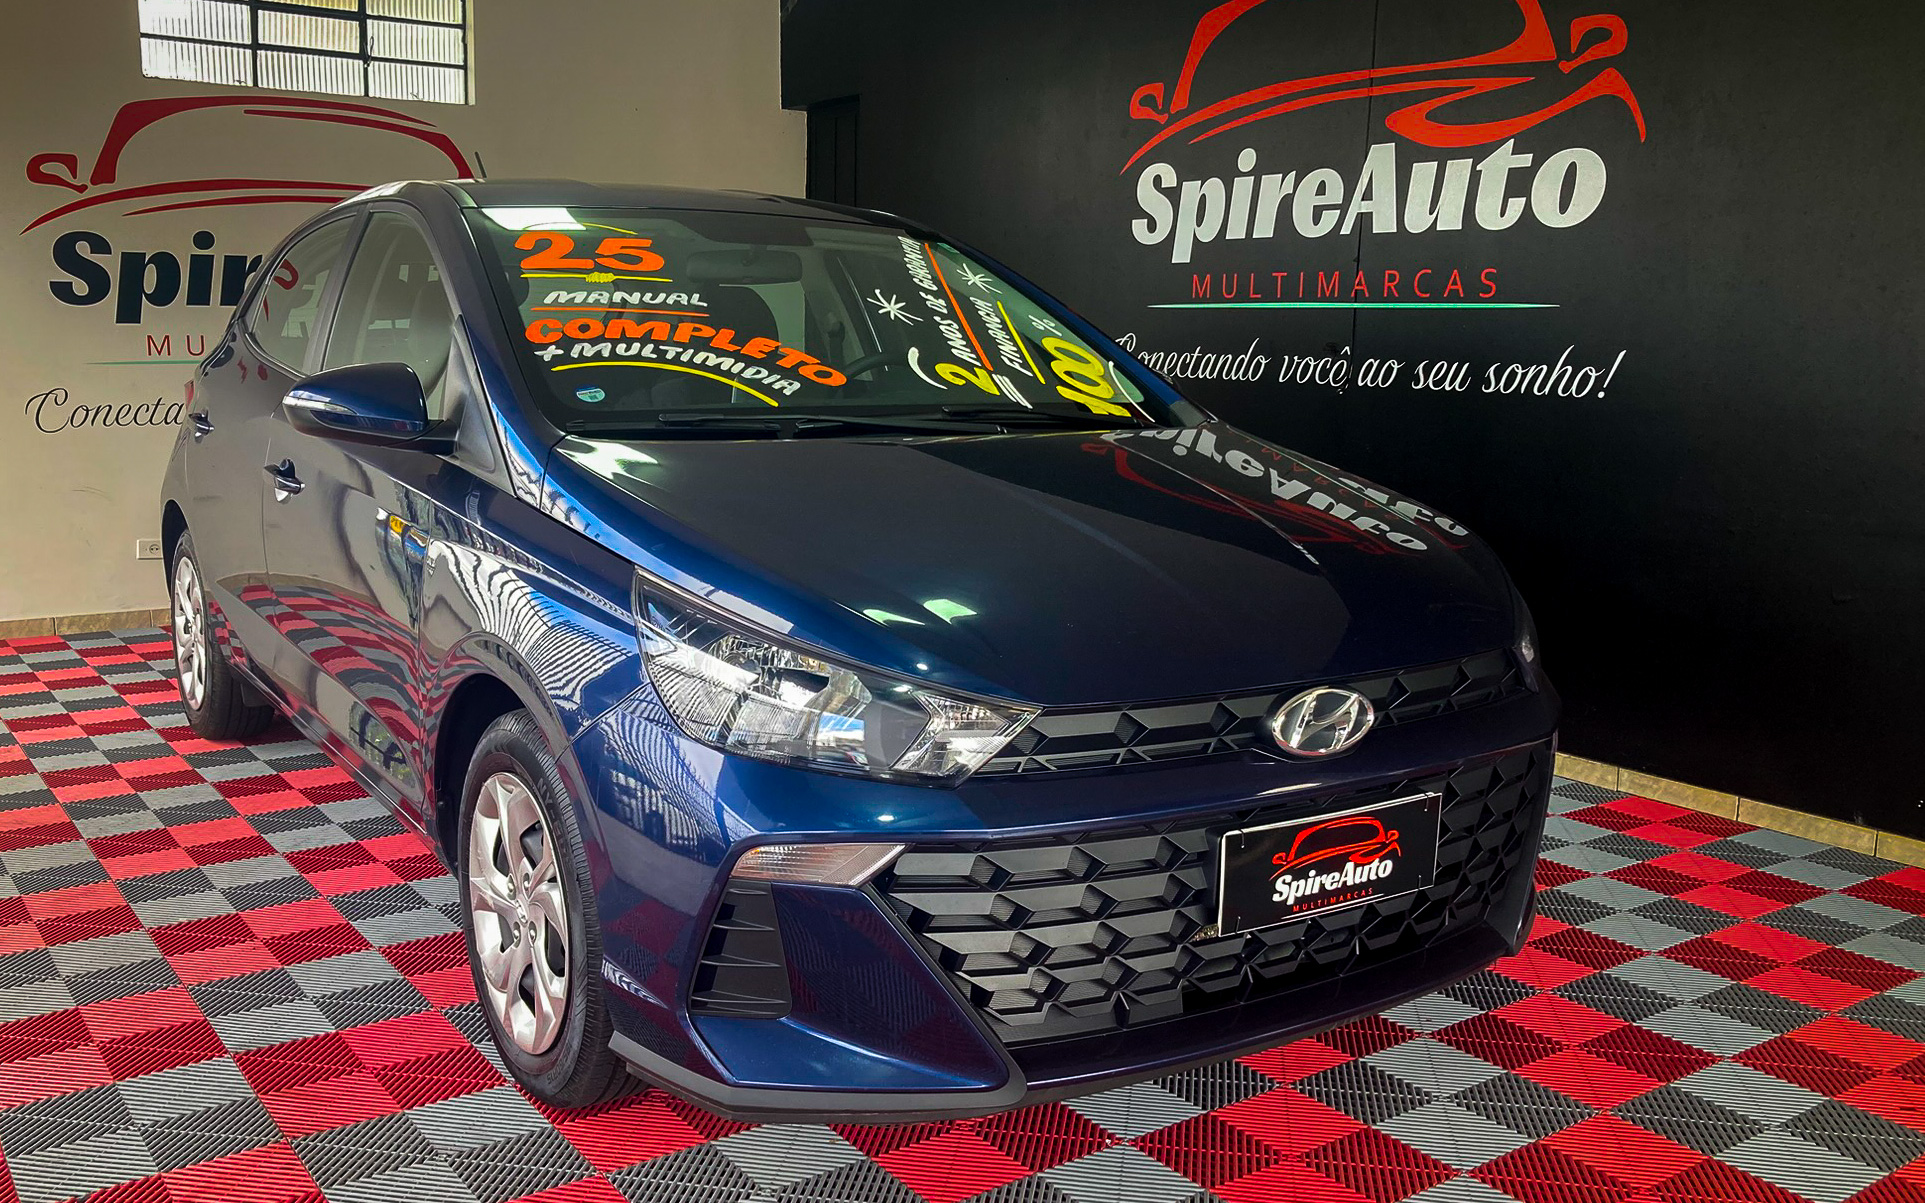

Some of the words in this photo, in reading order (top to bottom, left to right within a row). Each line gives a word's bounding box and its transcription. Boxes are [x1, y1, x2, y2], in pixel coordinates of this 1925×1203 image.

[1131, 138, 1607, 264] SpireAuto
[514, 231, 665, 272] 25
[543, 290, 708, 307] MANUAL
[919, 291, 948, 314] DE
[1192, 268, 1498, 300] MULTIMARCAS
[525, 318, 847, 387] COMPLETO
[933, 315, 982, 367] ANOS
[969, 296, 1034, 377] FINANCIA
[570, 342, 801, 396] MULTIMIDIA
[1278, 345, 1351, 387] você
[1357, 358, 1405, 388] ao
[1411, 356, 1476, 392] seu
[1481, 344, 1627, 399] sonho!
[1272, 859, 1393, 906] SpireAuto
[1292, 887, 1374, 912] MULTIMARCAS
